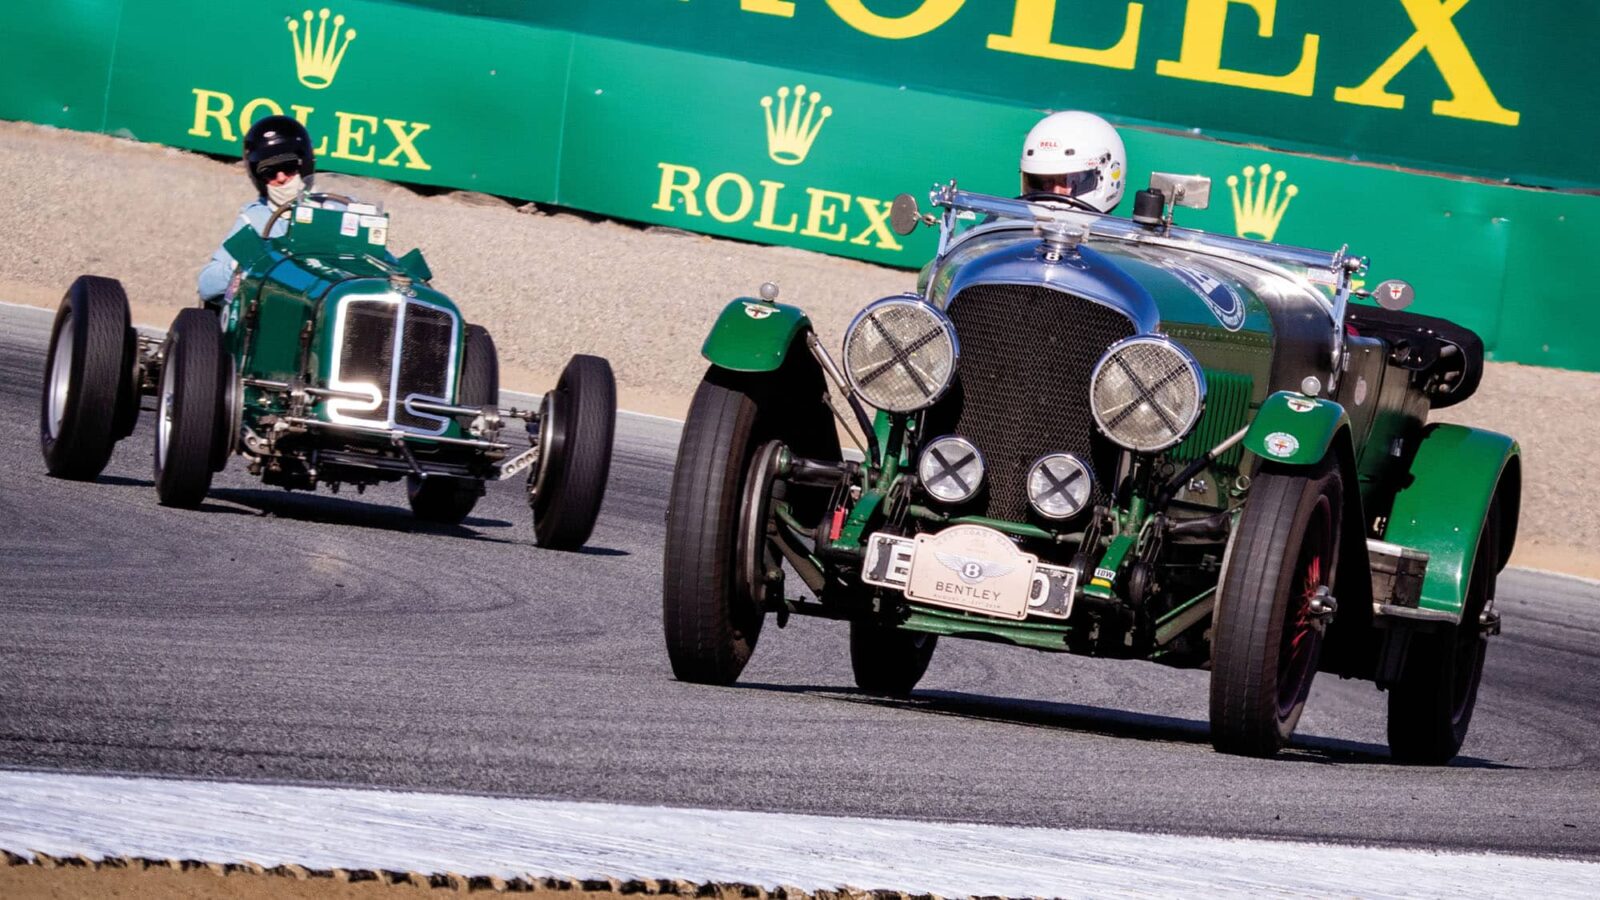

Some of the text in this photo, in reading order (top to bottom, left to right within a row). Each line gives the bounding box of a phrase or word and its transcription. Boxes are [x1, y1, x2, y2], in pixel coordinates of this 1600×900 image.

[679, 0, 1519, 126] LEX
[189, 89, 431, 170] ROLEX
[651, 163, 901, 250] ROLEX
[935, 581, 1001, 601] BENTLEY
